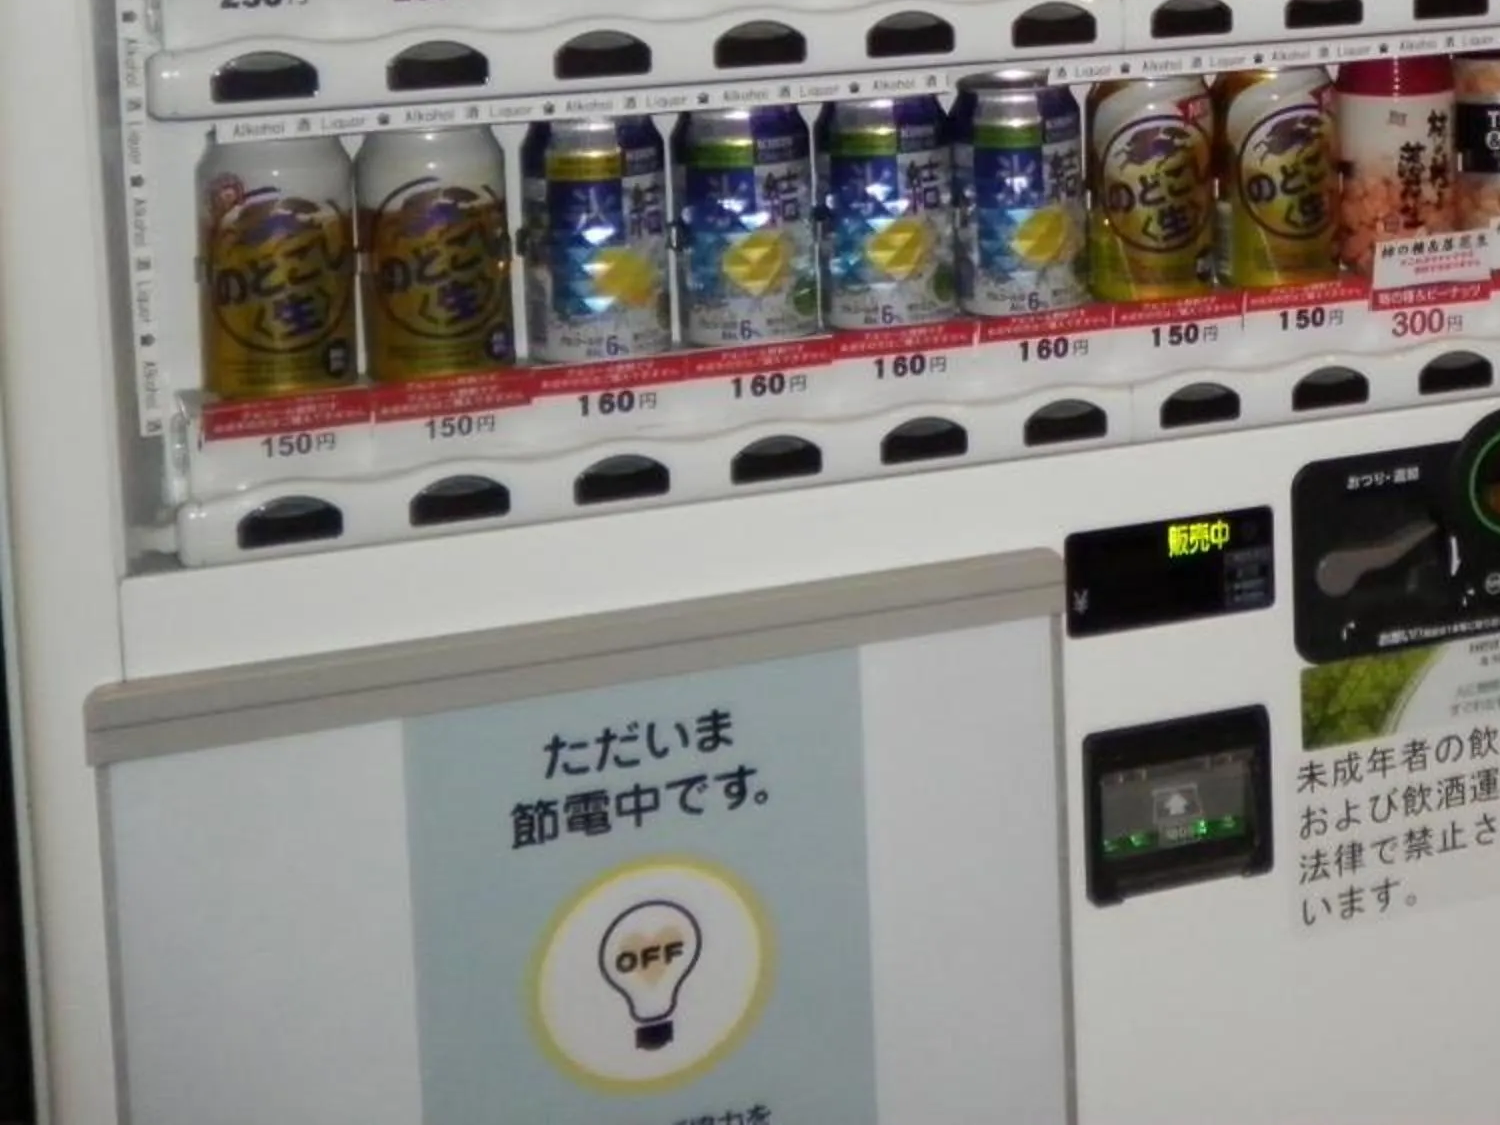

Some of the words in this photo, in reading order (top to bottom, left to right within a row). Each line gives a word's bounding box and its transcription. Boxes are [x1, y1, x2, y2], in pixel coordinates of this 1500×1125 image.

[1278, 306, 1344, 331] 150円
[1391, 308, 1464, 337] 300円
[1019, 336, 1089, 362] 160円
[1151, 324, 1219, 348] 150円
[873, 353, 947, 380] 160円
[730, 371, 807, 398] 160円
[578, 389, 658, 417] 160円
[424, 414, 496, 440] 150円
[260, 431, 337, 459] 150円
[1167, 518, 1231, 560] 販売中
[543, 707, 734, 780] ただいま
[509, 763, 769, 851] 節電中です。
[1302, 877, 1418, 927] います。
[615, 941, 685, 975] OFF
